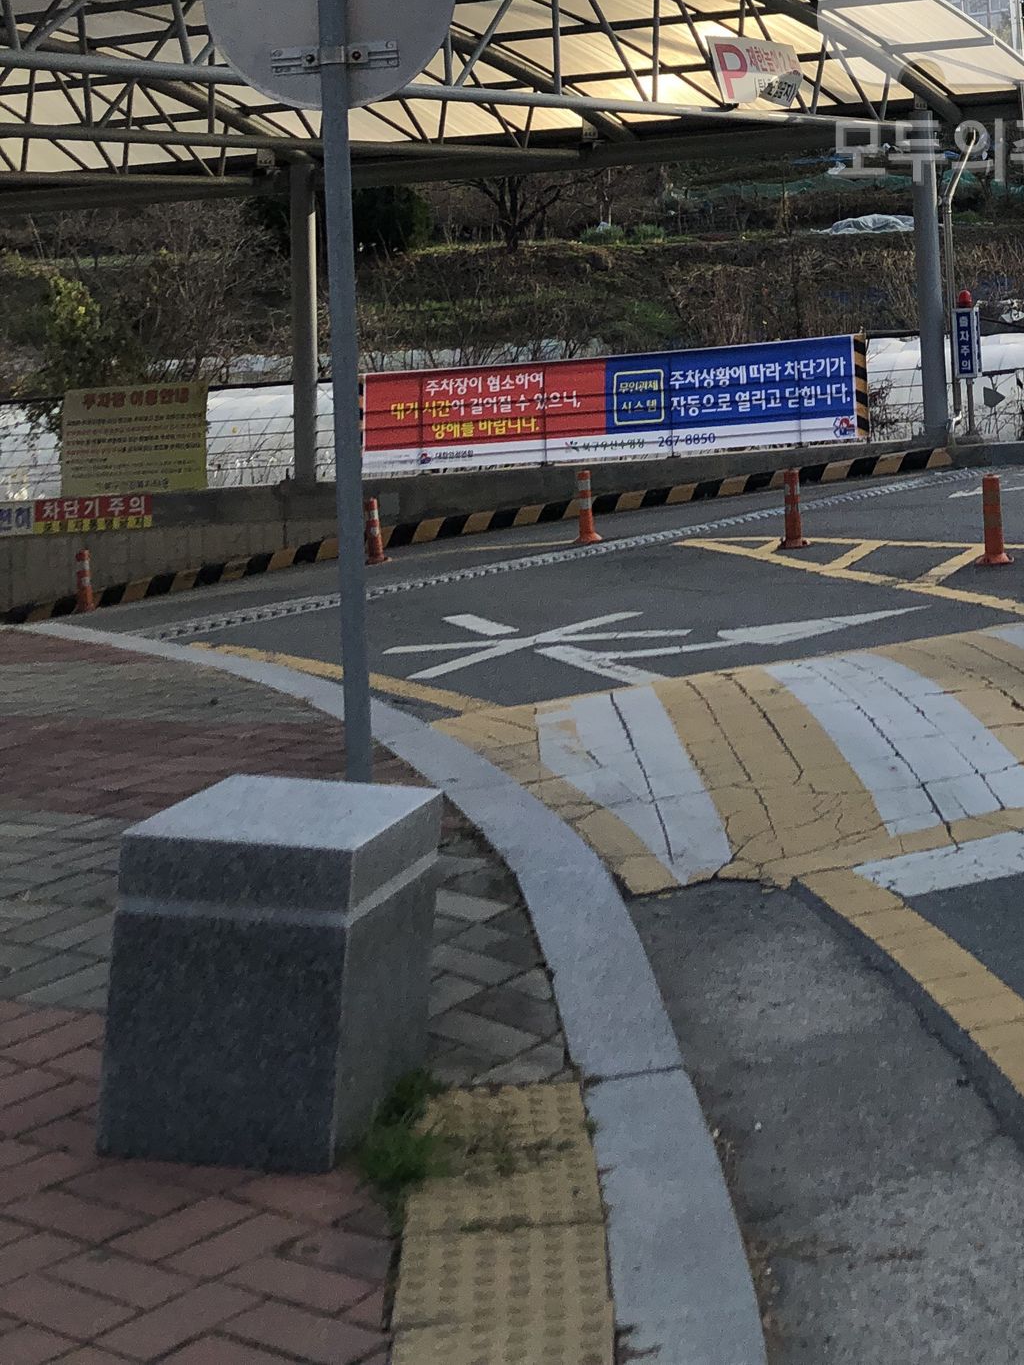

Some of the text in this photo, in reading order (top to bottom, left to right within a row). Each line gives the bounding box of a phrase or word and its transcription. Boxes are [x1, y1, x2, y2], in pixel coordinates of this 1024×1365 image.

[714, 44, 748, 99] P
[425, 371, 544, 397] 주차장이 협소하여
[670, 356, 847, 390] 주차상황에 따라 차단기가
[390, 401, 419, 419] 대기
[423, 398, 465, 418] 시간이
[470, 394, 513, 414] 길어질
[515, 393, 532, 412] 수
[621, 399, 658, 414] 시스템
[670, 382, 851, 417] 자동으로 열리고 닫힙니다.
[431, 419, 475, 440] 양해를
[657, 433, 717, 448] 267-8850
[42, 495, 146, 521] 차단기 주의
